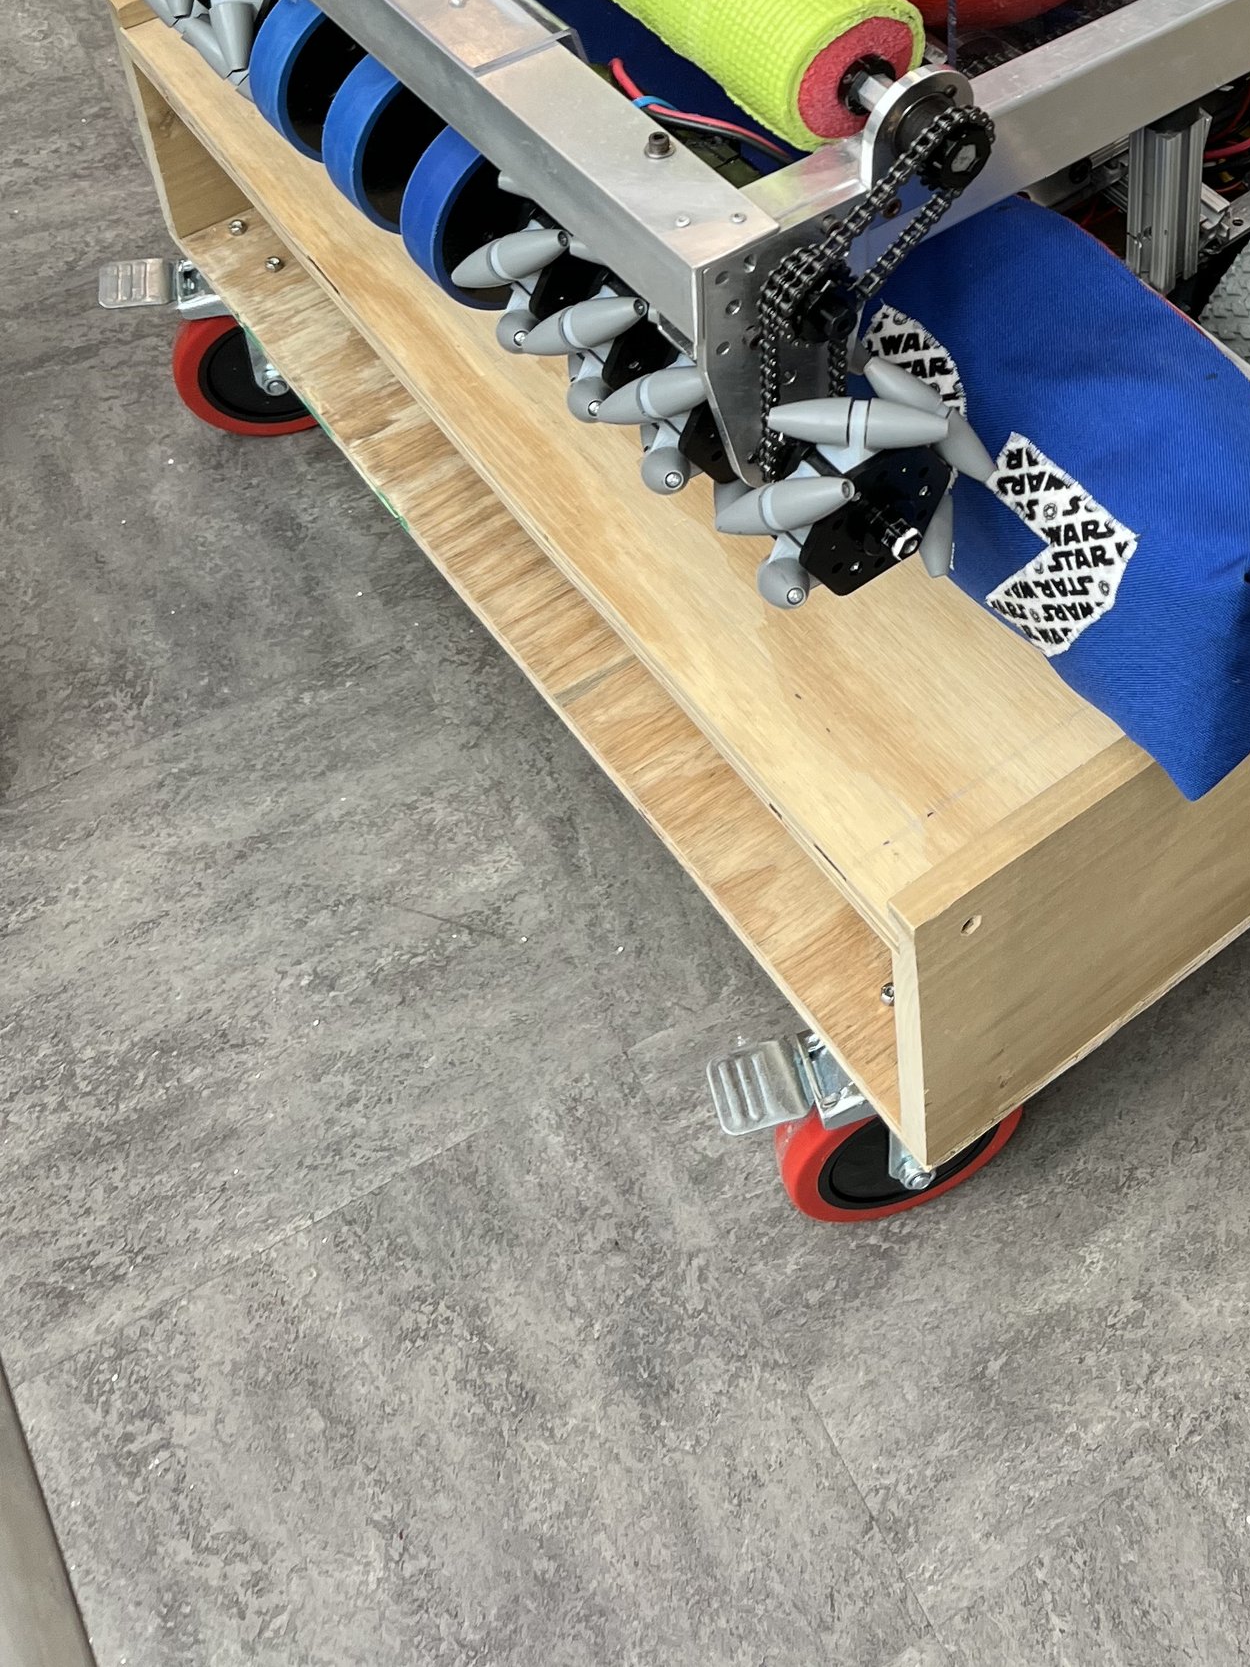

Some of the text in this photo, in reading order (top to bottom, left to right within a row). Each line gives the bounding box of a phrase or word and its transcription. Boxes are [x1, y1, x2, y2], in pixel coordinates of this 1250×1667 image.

[1047, 544, 1115, 573] STAR
[1032, 575, 1095, 598] STAR
[1041, 602, 1095, 622] WARS
